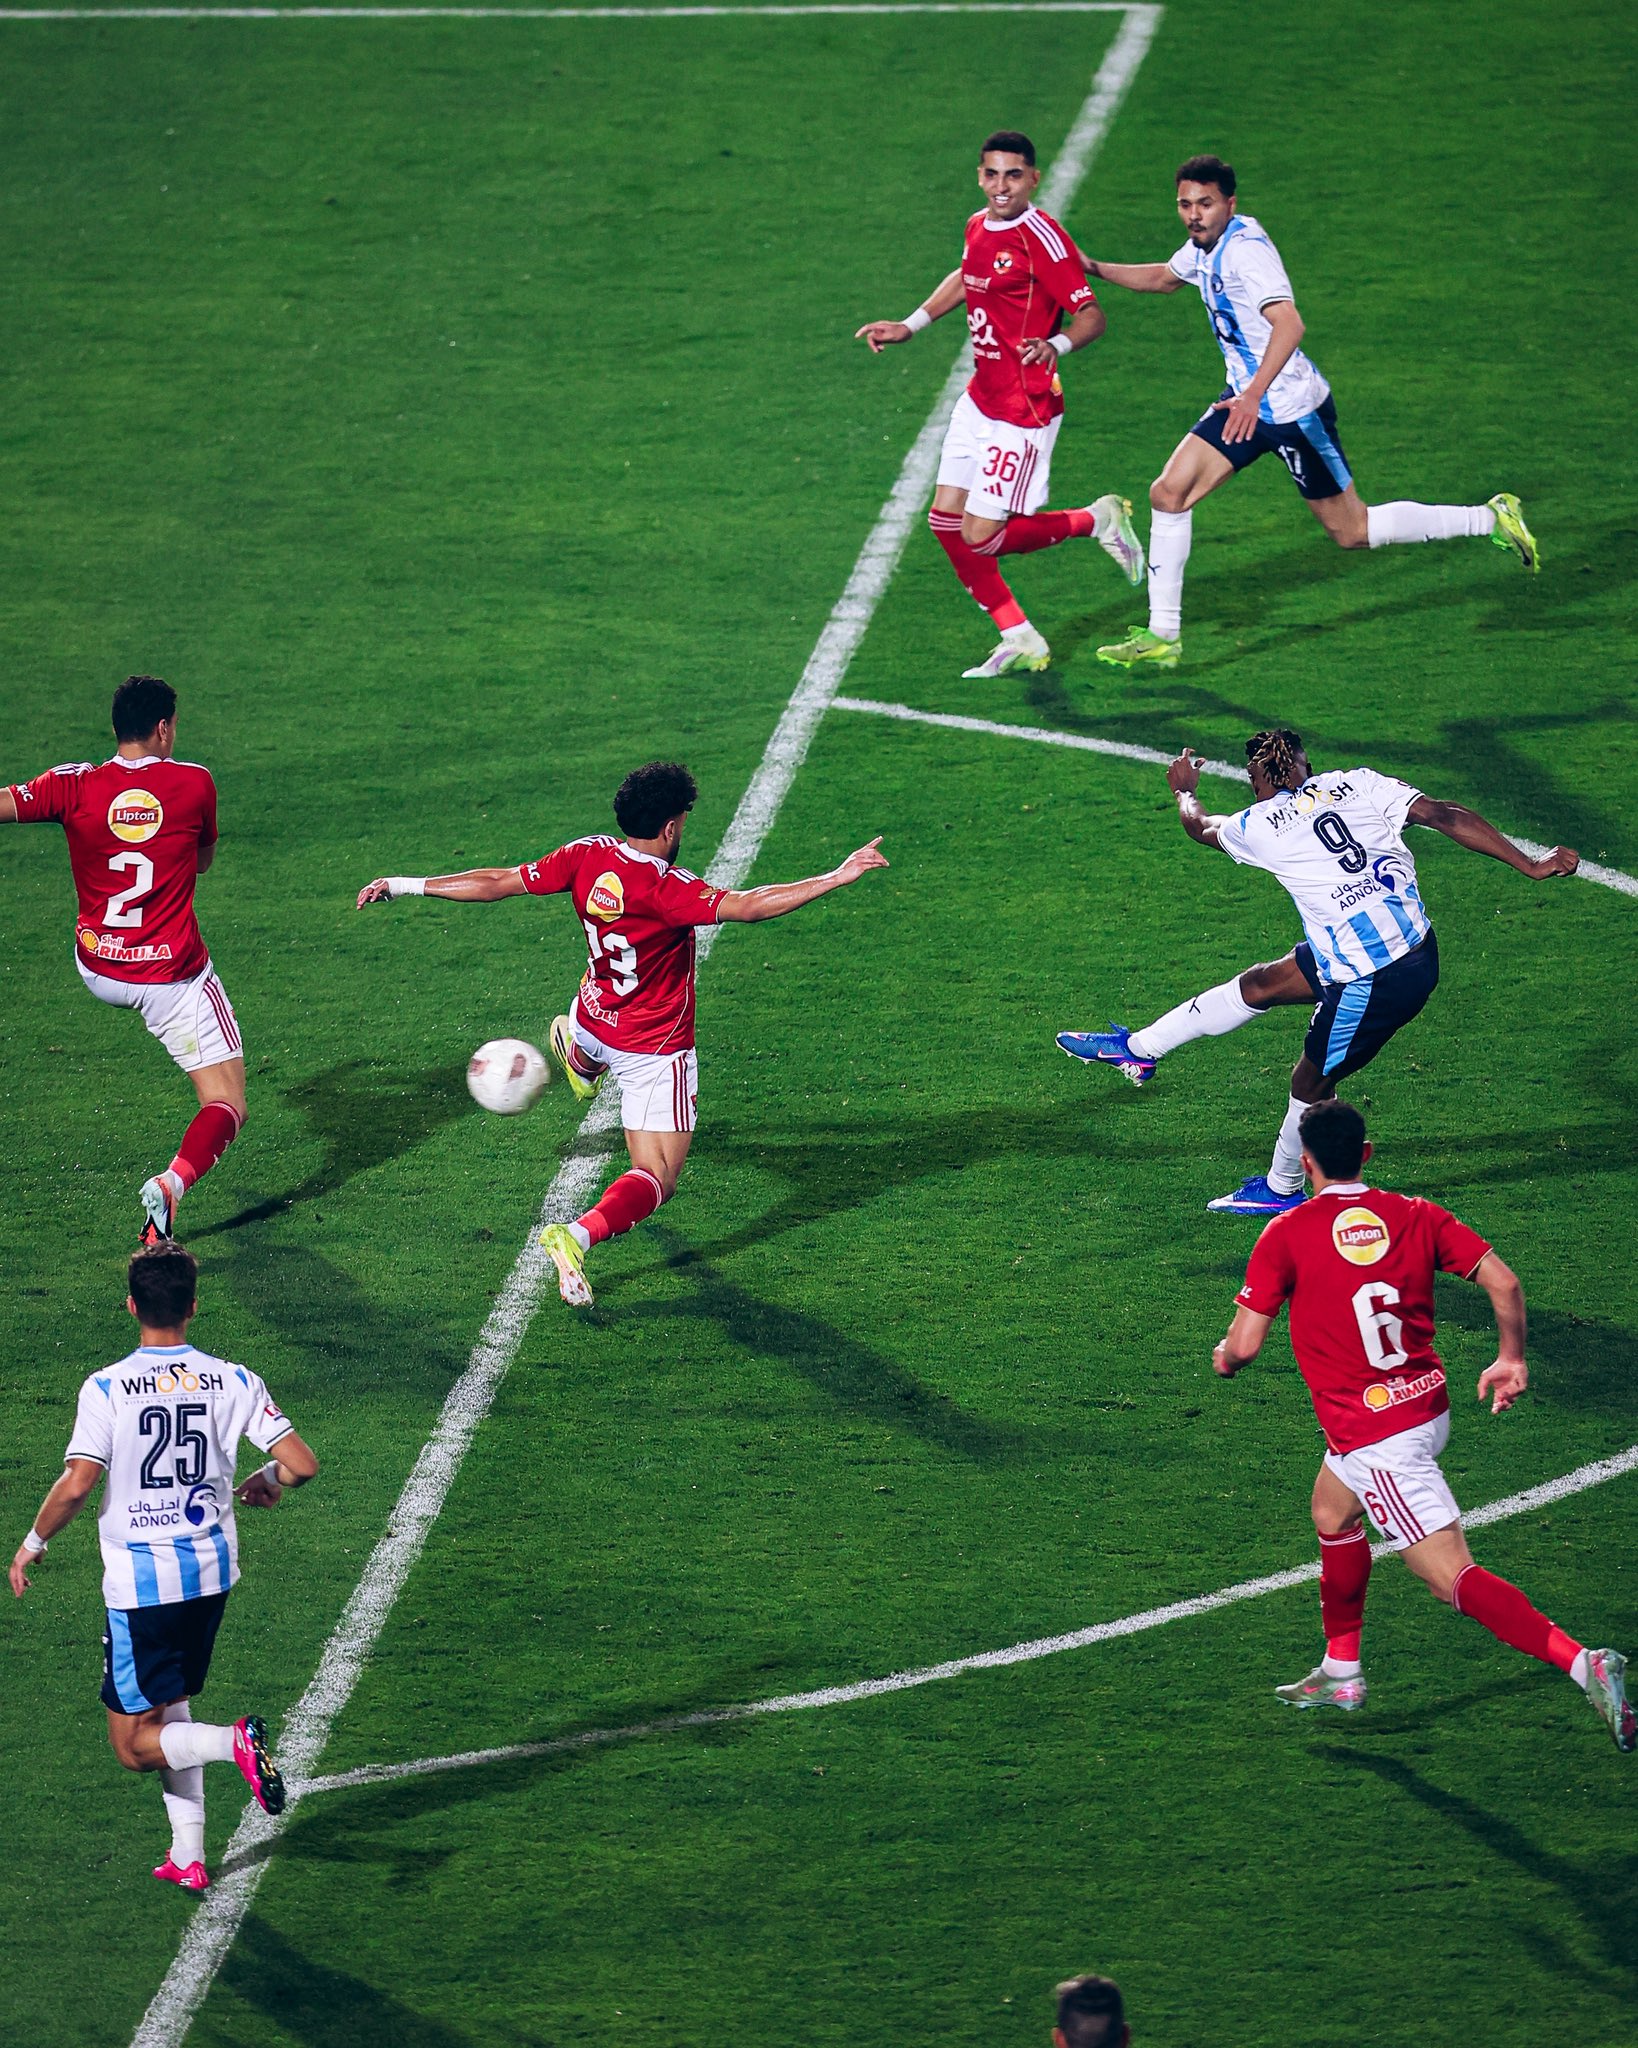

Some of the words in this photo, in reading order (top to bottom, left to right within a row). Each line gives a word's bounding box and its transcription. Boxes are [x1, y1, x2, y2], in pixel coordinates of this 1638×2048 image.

[982, 446, 1020, 482] 36
[1278, 445, 1302, 475] 17
[116, 810, 155, 823] Lipton
[1313, 811, 1367, 873] 9
[102, 851, 154, 928] 2
[594, 888, 617, 909] Lipton
[100, 945, 171, 961] RIMULA
[101, 934, 123, 947] Shell
[583, 918, 640, 997] 13
[1341, 1229, 1382, 1244] Lipton
[1352, 1281, 1409, 1371] 6
[120, 1372, 224, 1396] WHOOSH
[1392, 1370, 1444, 1403] RIMULA
[138, 1402, 208, 1490] 25
[129, 1512, 180, 1529] ADNOC
[1364, 1491, 1389, 1526] 6
